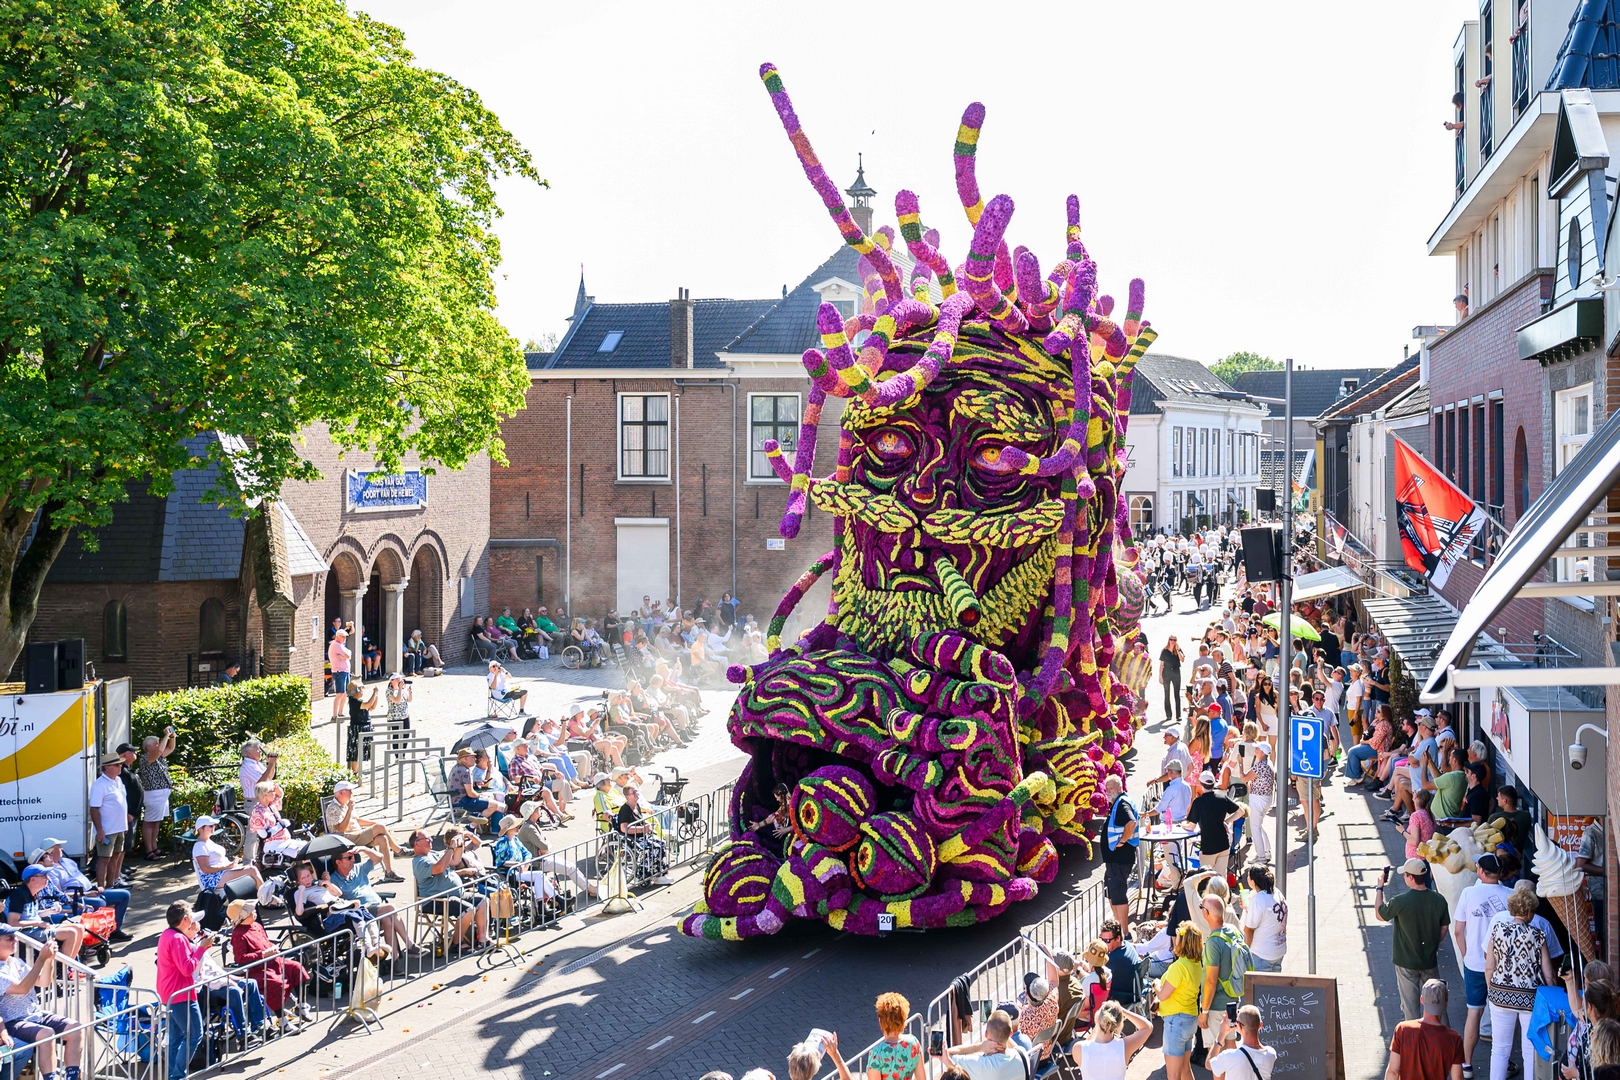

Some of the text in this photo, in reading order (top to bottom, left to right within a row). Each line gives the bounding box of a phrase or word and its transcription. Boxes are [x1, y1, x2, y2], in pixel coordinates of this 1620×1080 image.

[385, 477, 395, 486] VAN
[395, 476, 406, 486] GOD
[362, 488, 414, 499] POORT VAN DE HEMEL
[21, 722, 34, 732] .nl
[1298, 722, 1315, 751] P
[0, 812, 67, 823] omvoorziening
[880, 915, 891, 923] 20
